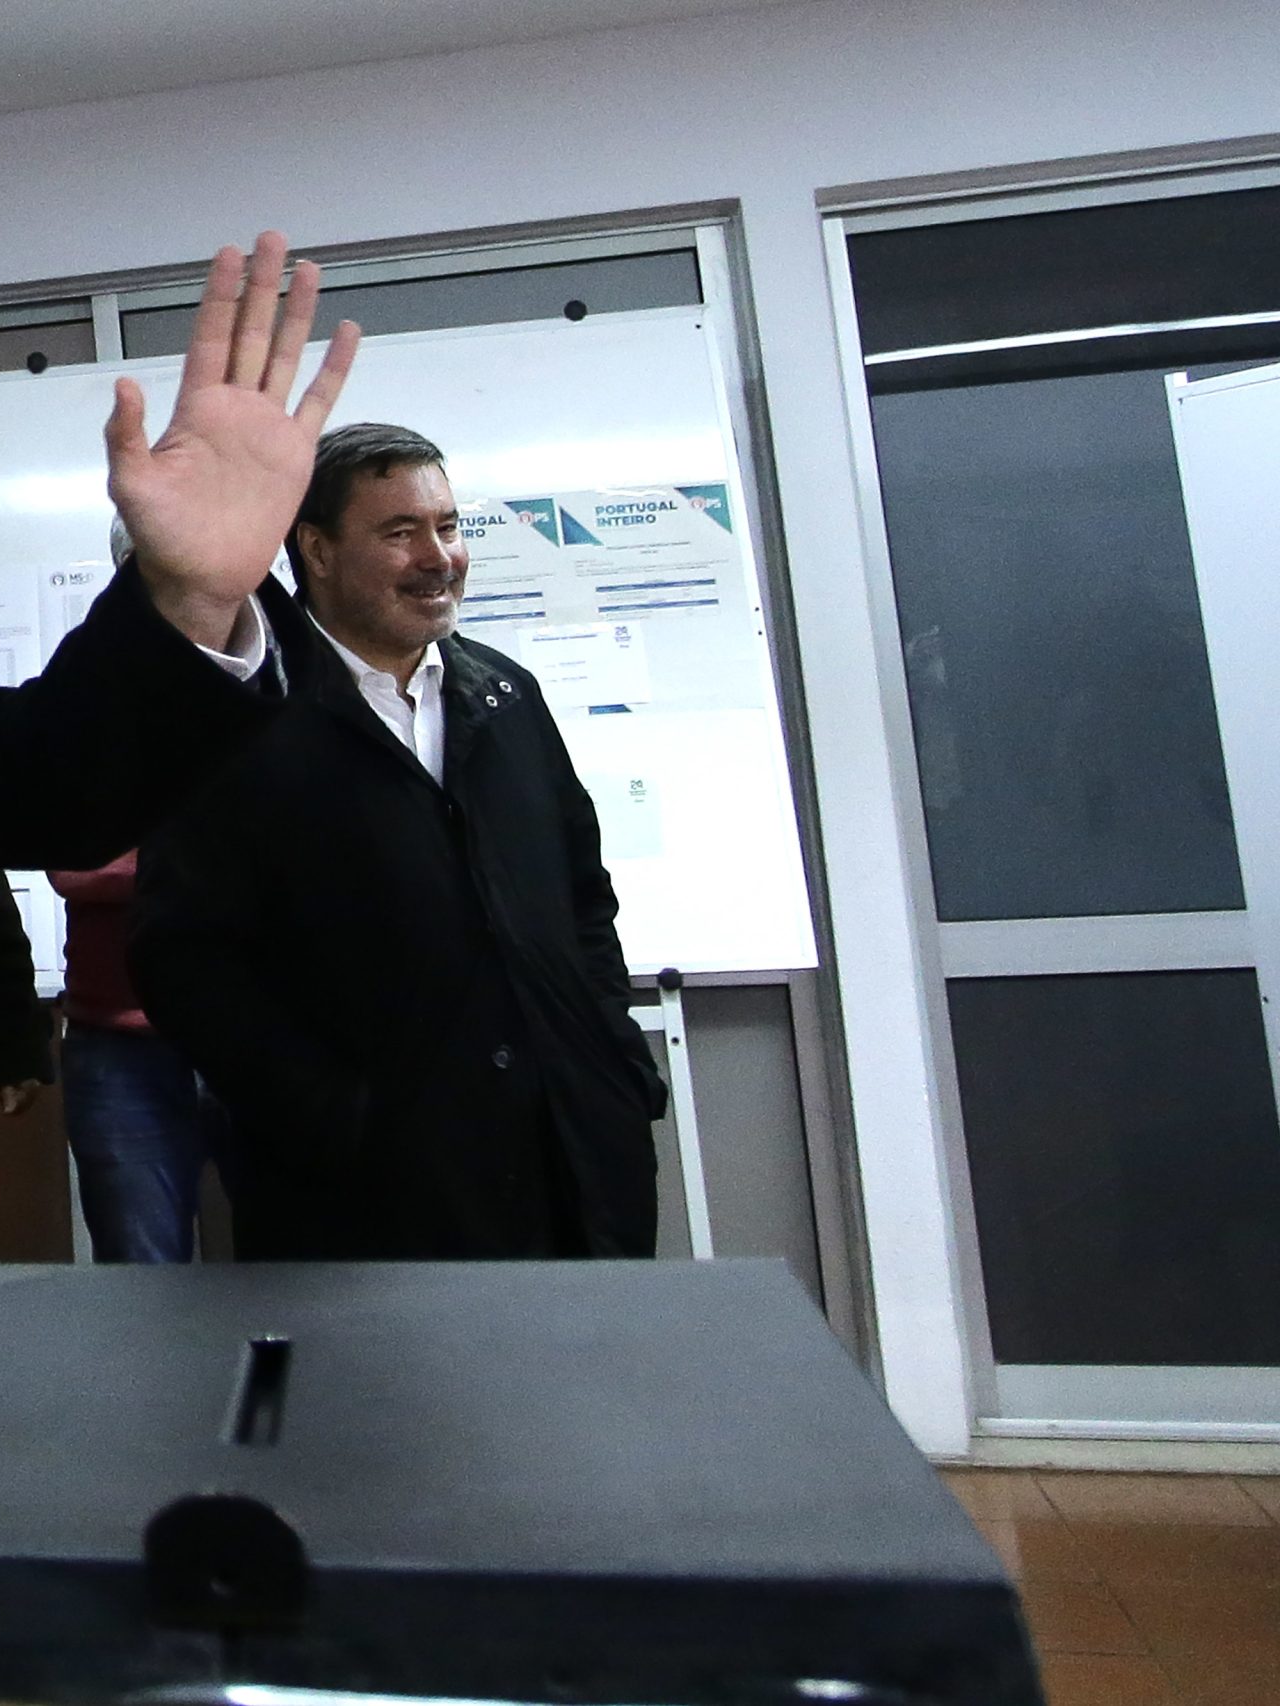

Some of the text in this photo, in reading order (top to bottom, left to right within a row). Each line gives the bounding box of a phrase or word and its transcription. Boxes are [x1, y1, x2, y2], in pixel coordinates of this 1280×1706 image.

[594, 500, 678, 516] PORTUGAL
[459, 515, 507, 528] TUGAL
[596, 514, 657, 527] INTEIRO
[461, 528, 486, 539] IRO
